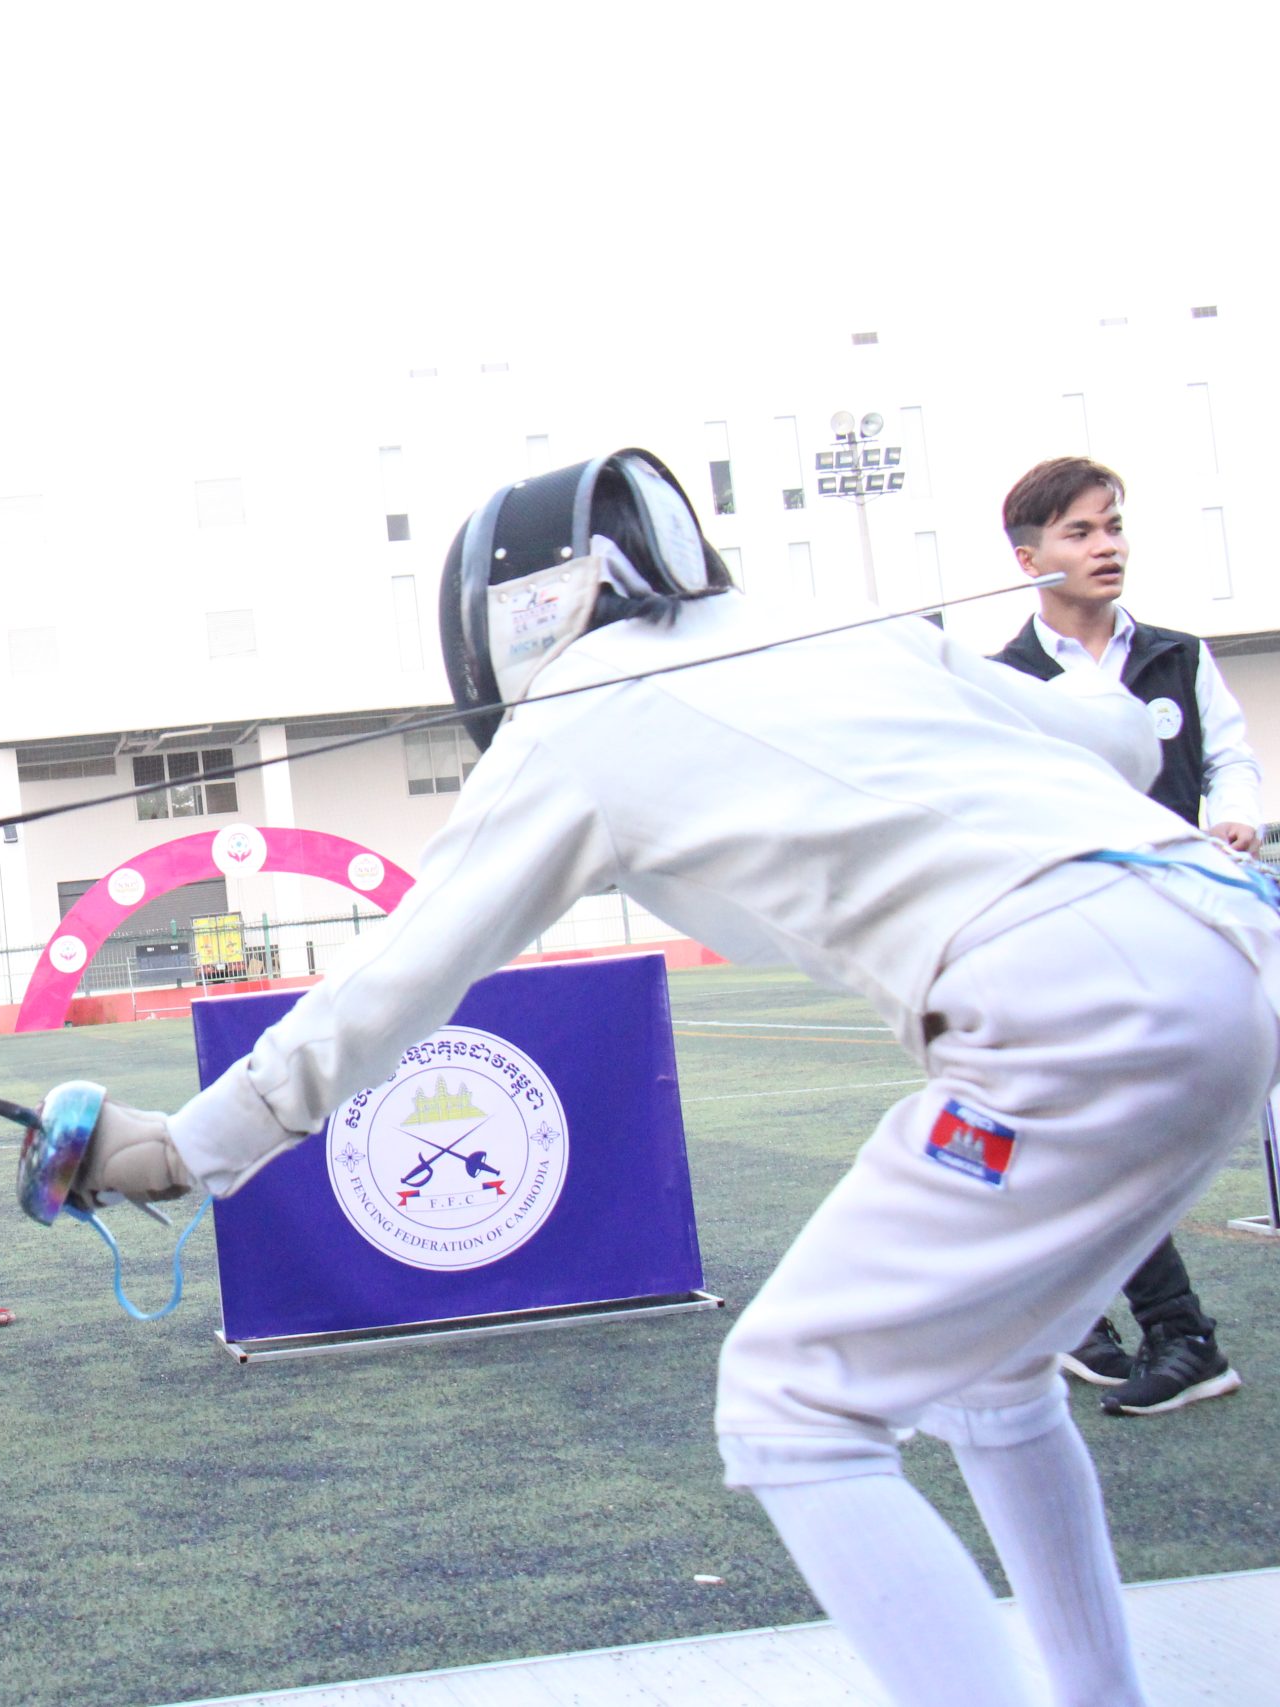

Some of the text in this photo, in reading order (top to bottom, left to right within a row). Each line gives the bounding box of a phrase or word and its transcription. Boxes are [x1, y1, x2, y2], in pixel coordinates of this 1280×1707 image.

[350, 1159, 550, 1252] FENCING FEDERATION OF CAMBODIA
